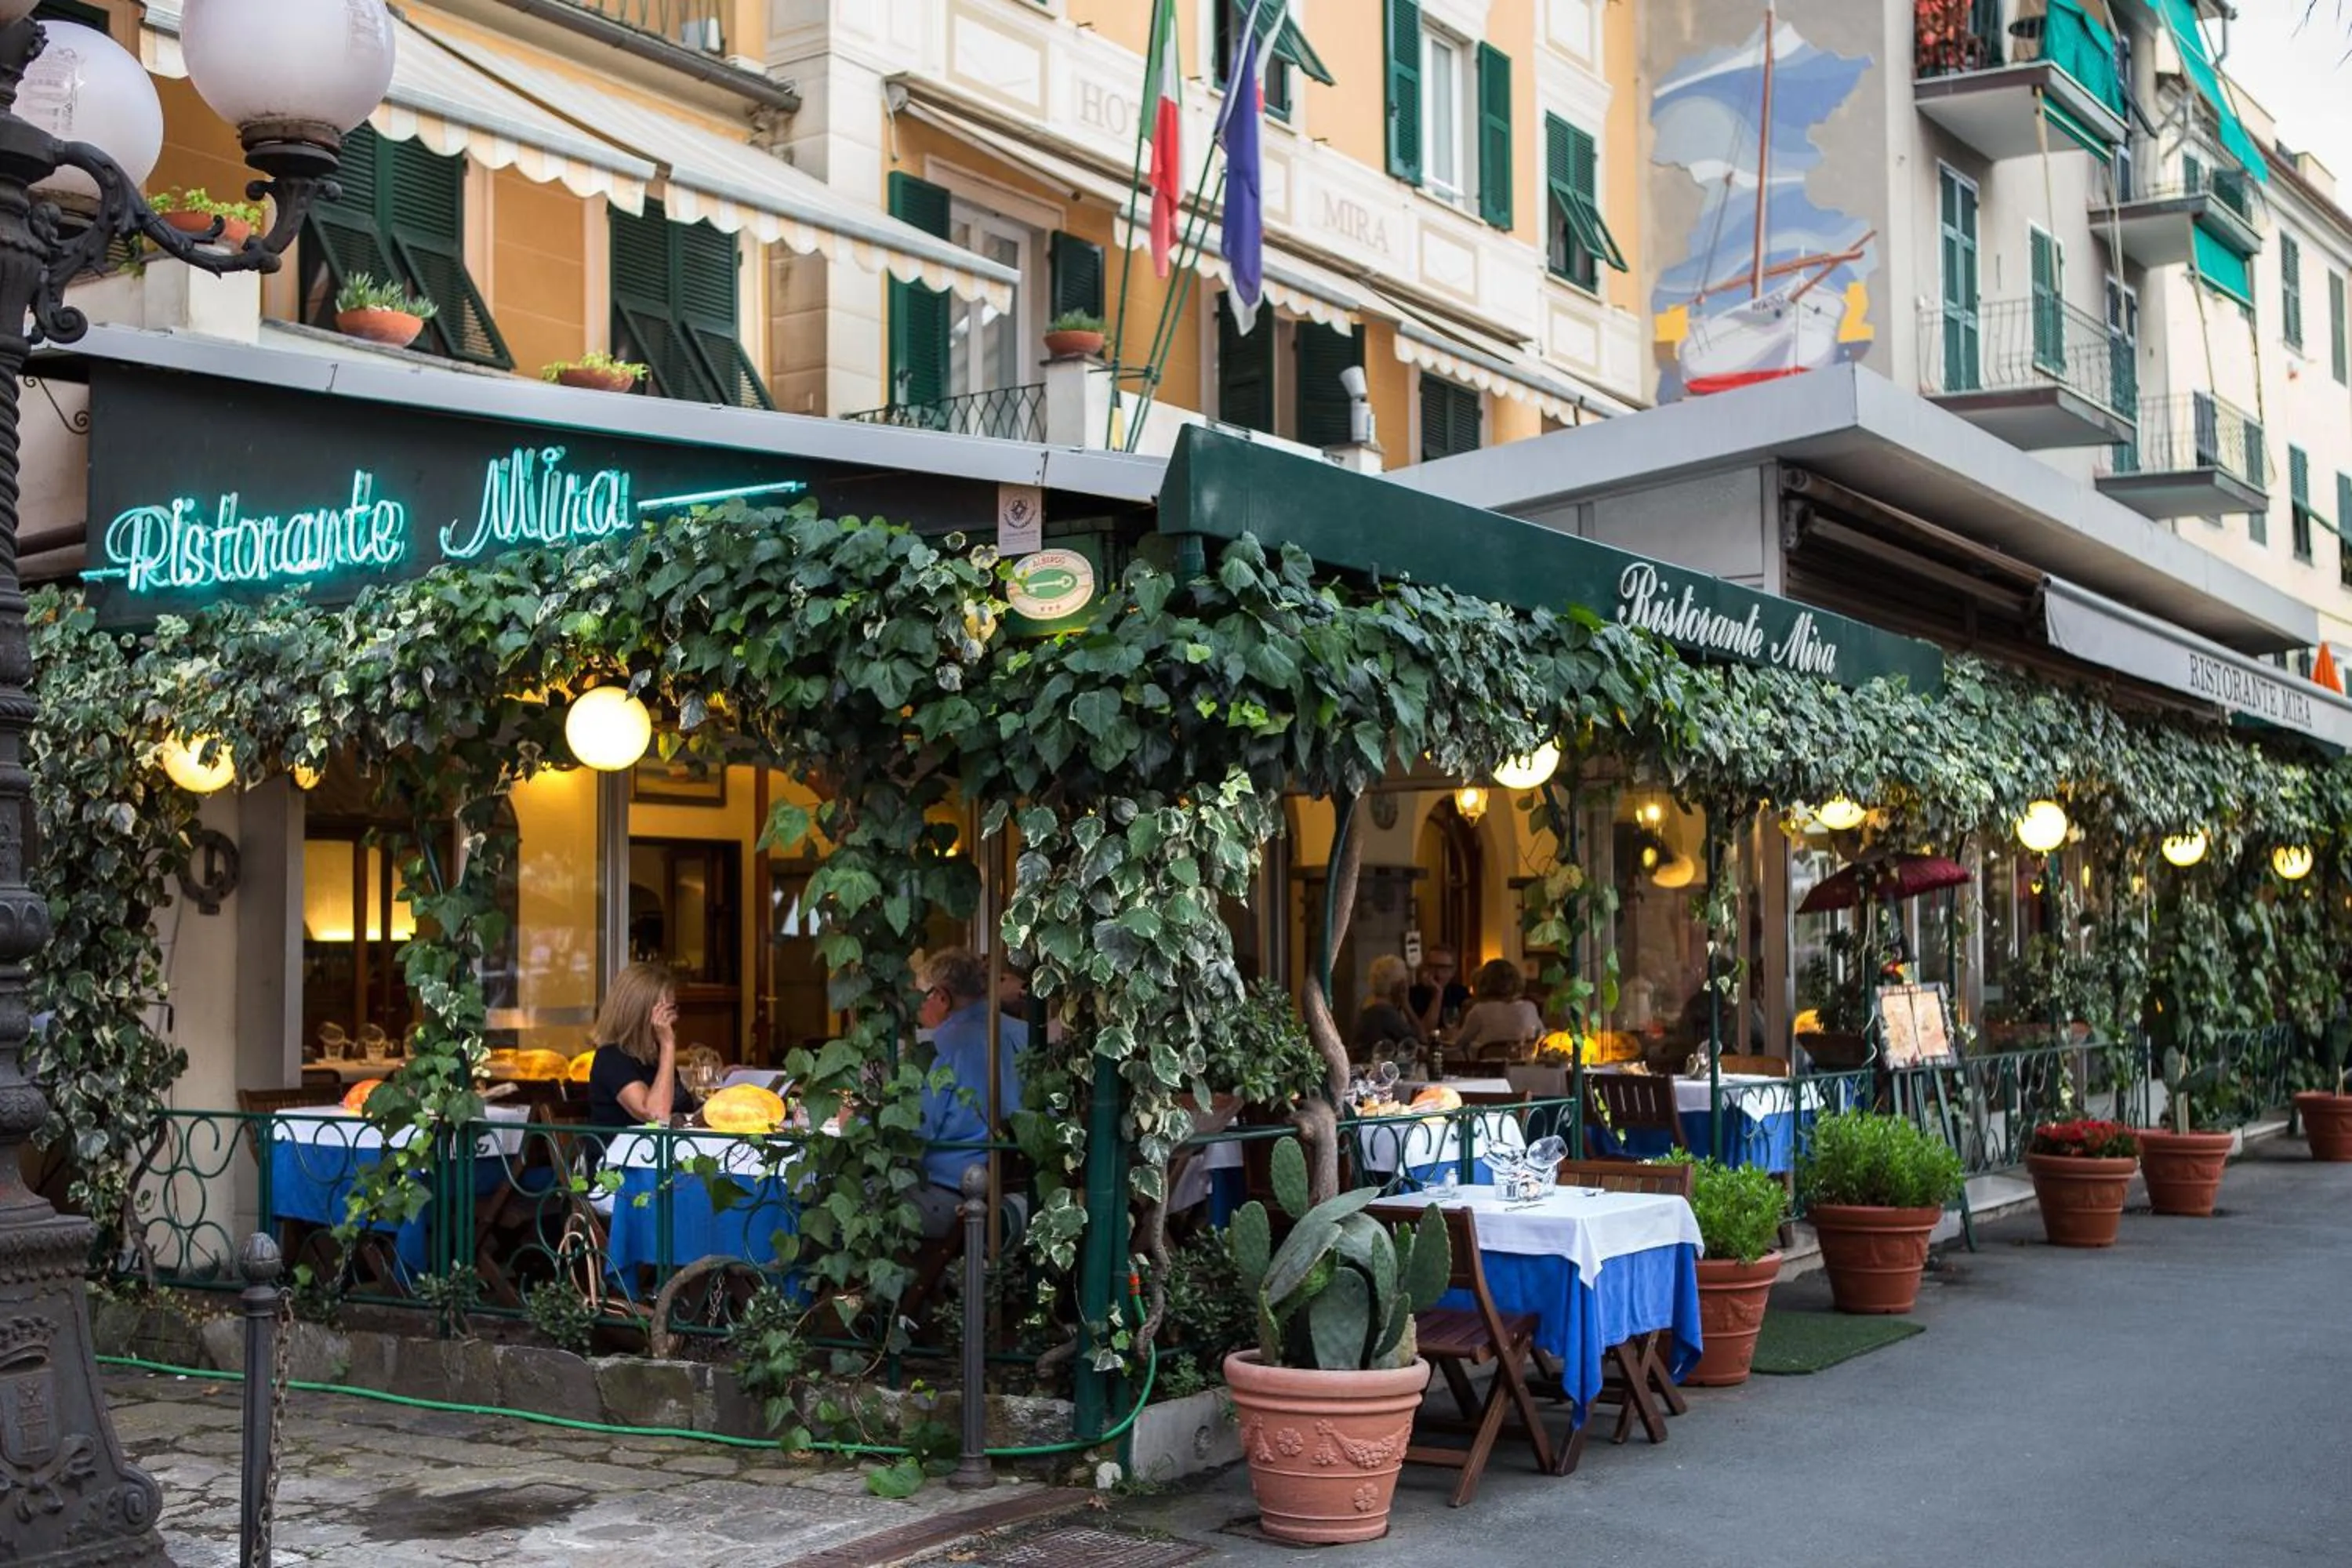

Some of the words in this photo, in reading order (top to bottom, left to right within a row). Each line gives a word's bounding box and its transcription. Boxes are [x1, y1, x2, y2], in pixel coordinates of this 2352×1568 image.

[1322, 190, 1389, 252] MIRA
[105, 470, 405, 591] Ristorante
[439, 447, 633, 557] Mira
[1617, 562, 1764, 659] Ristorante
[1770, 612, 1837, 674] Mira
[2190, 653, 2278, 717] RISTORANTE
[2282, 687, 2313, 729] MIRA
